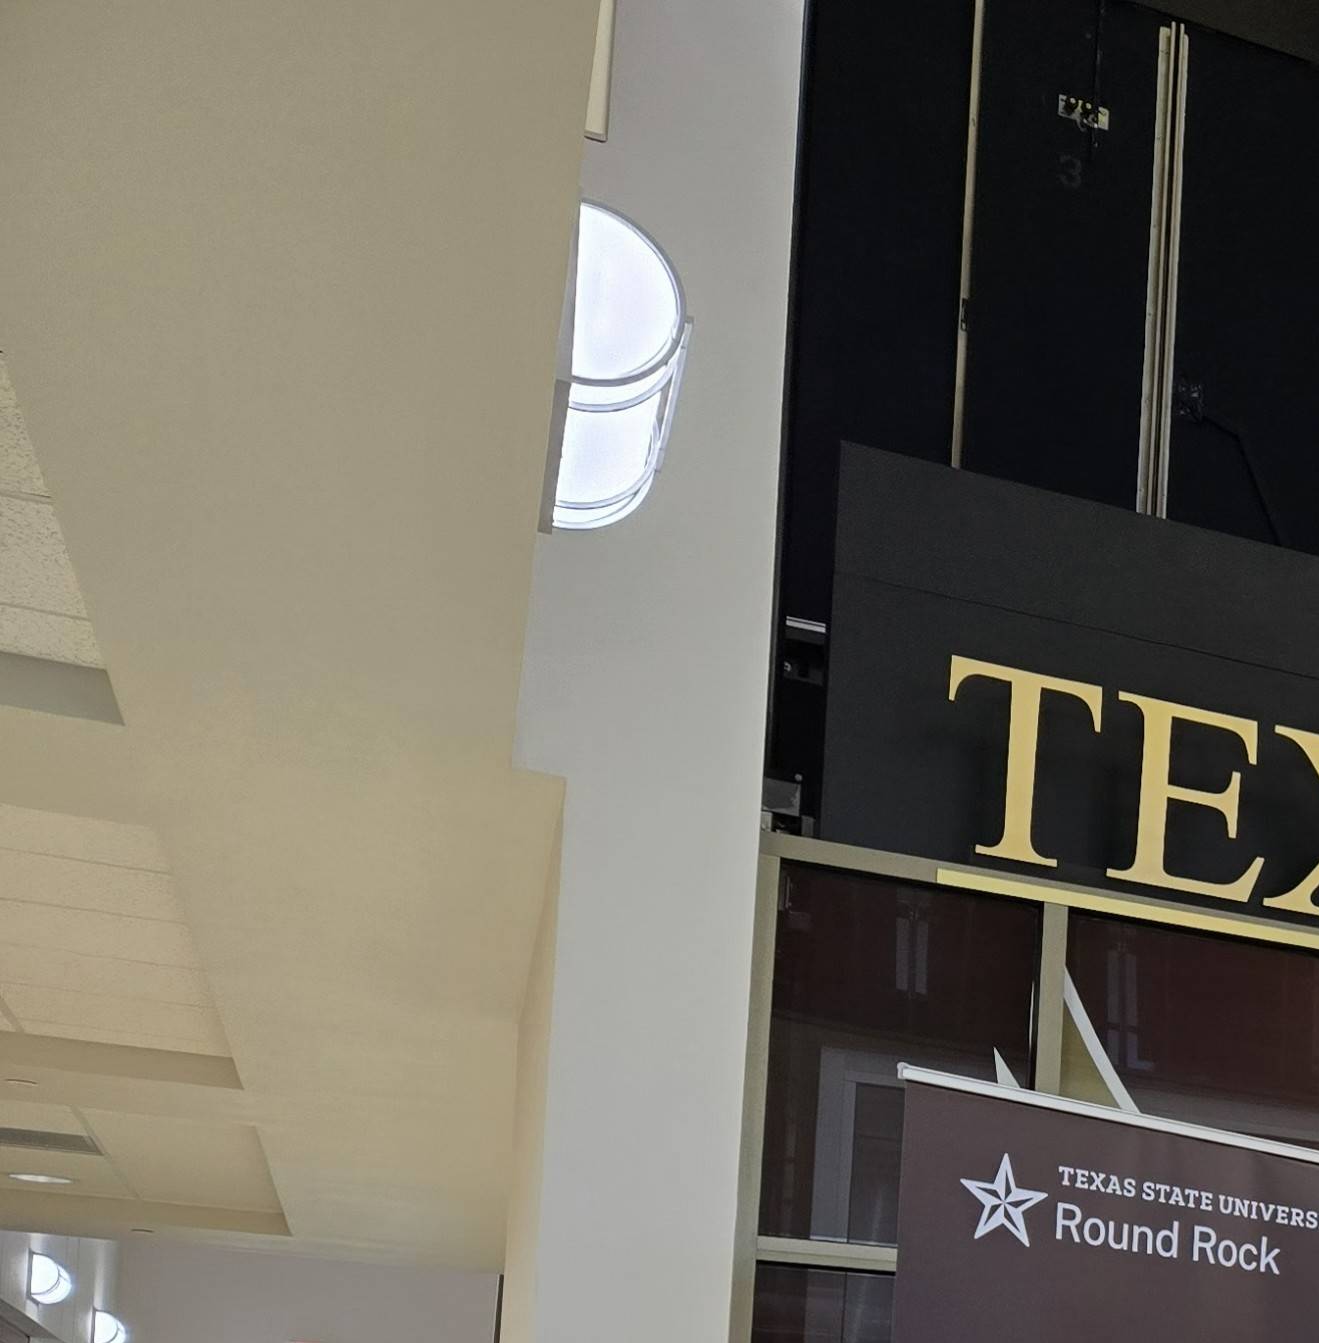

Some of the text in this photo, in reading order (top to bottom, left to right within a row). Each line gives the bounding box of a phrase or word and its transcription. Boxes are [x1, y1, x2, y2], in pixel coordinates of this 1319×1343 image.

[1058, 1165, 1137, 1198] TEXAS
[1141, 1181, 1213, 1211] STATE
[1055, 1201, 1281, 1275] Round Rock
